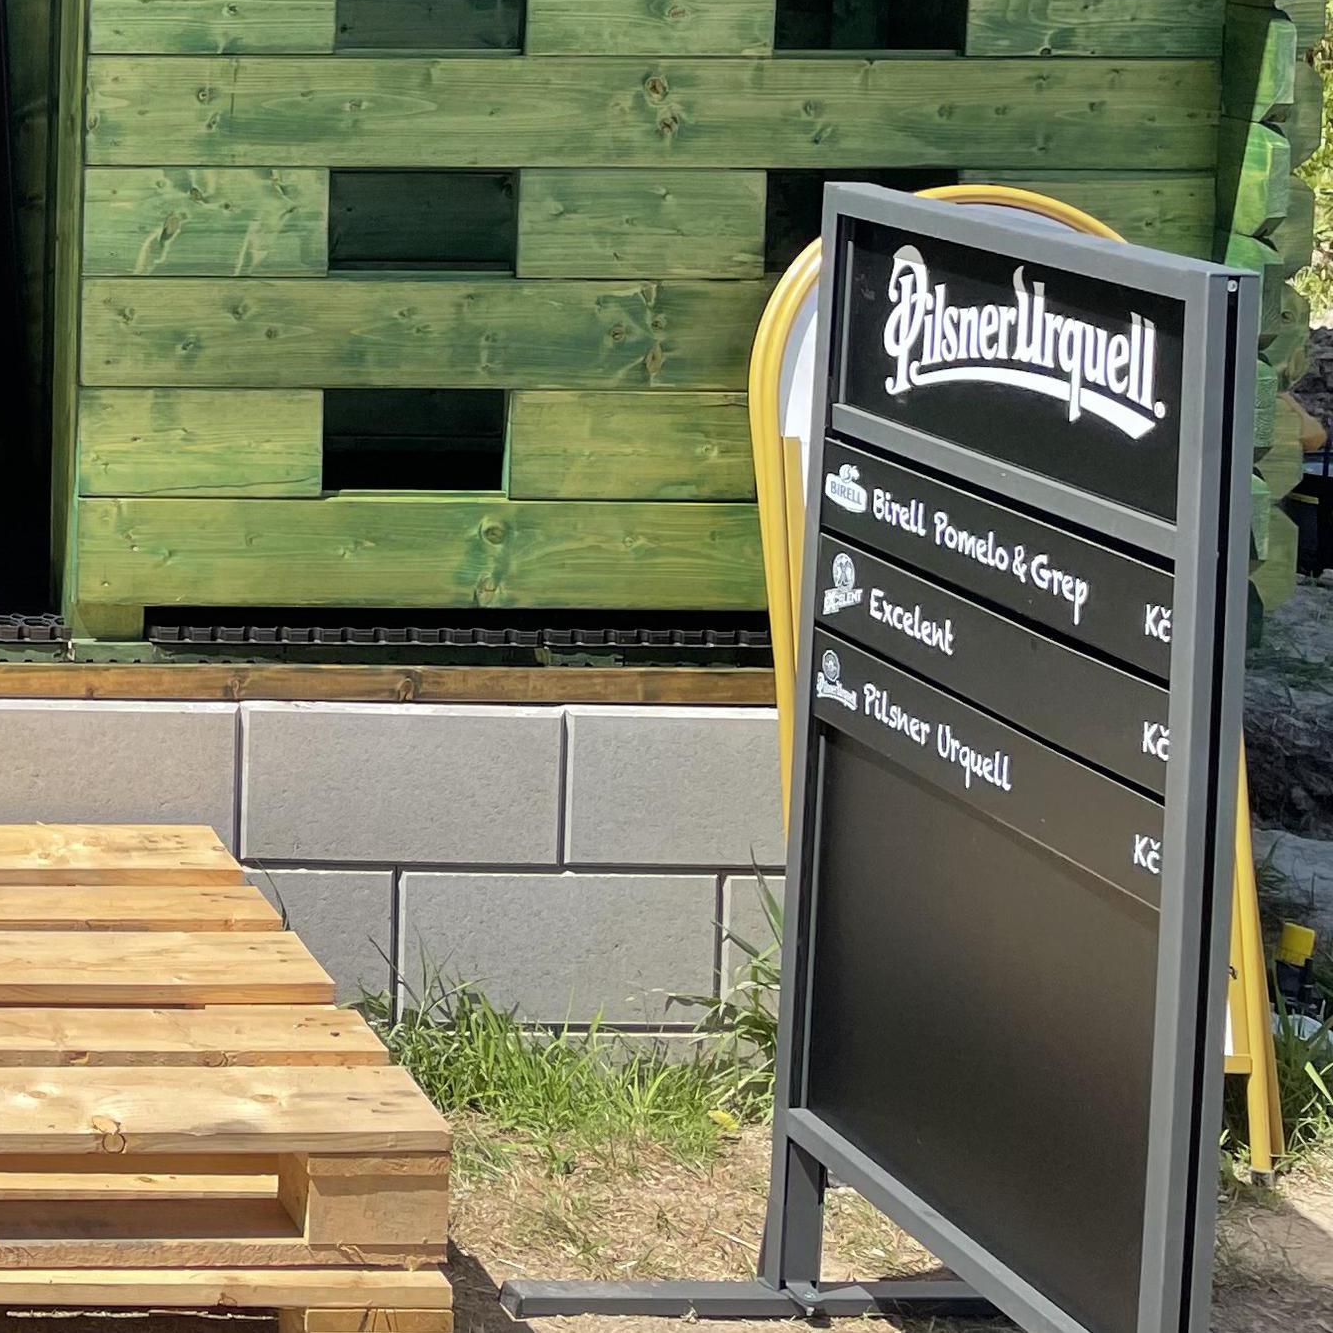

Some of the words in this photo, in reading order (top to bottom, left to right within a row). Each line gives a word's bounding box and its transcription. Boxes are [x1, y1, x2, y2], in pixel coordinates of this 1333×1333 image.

[830, 480, 863, 506] BIRELL
[872, 488, 927, 538] Birell
[934, 510, 1010, 571] Pomelo
[1012, 544, 1028, 584] &
[1030, 553, 1090, 626] Grep
[869, 587, 955, 656] Excelent
[1144, 602, 1173, 644] Kč
[863, 682, 931, 748] Pilsner
[936, 724, 1013, 792] Urquell
[1142, 721, 1171, 762] Kč
[1133, 834, 1162, 875] Kč
